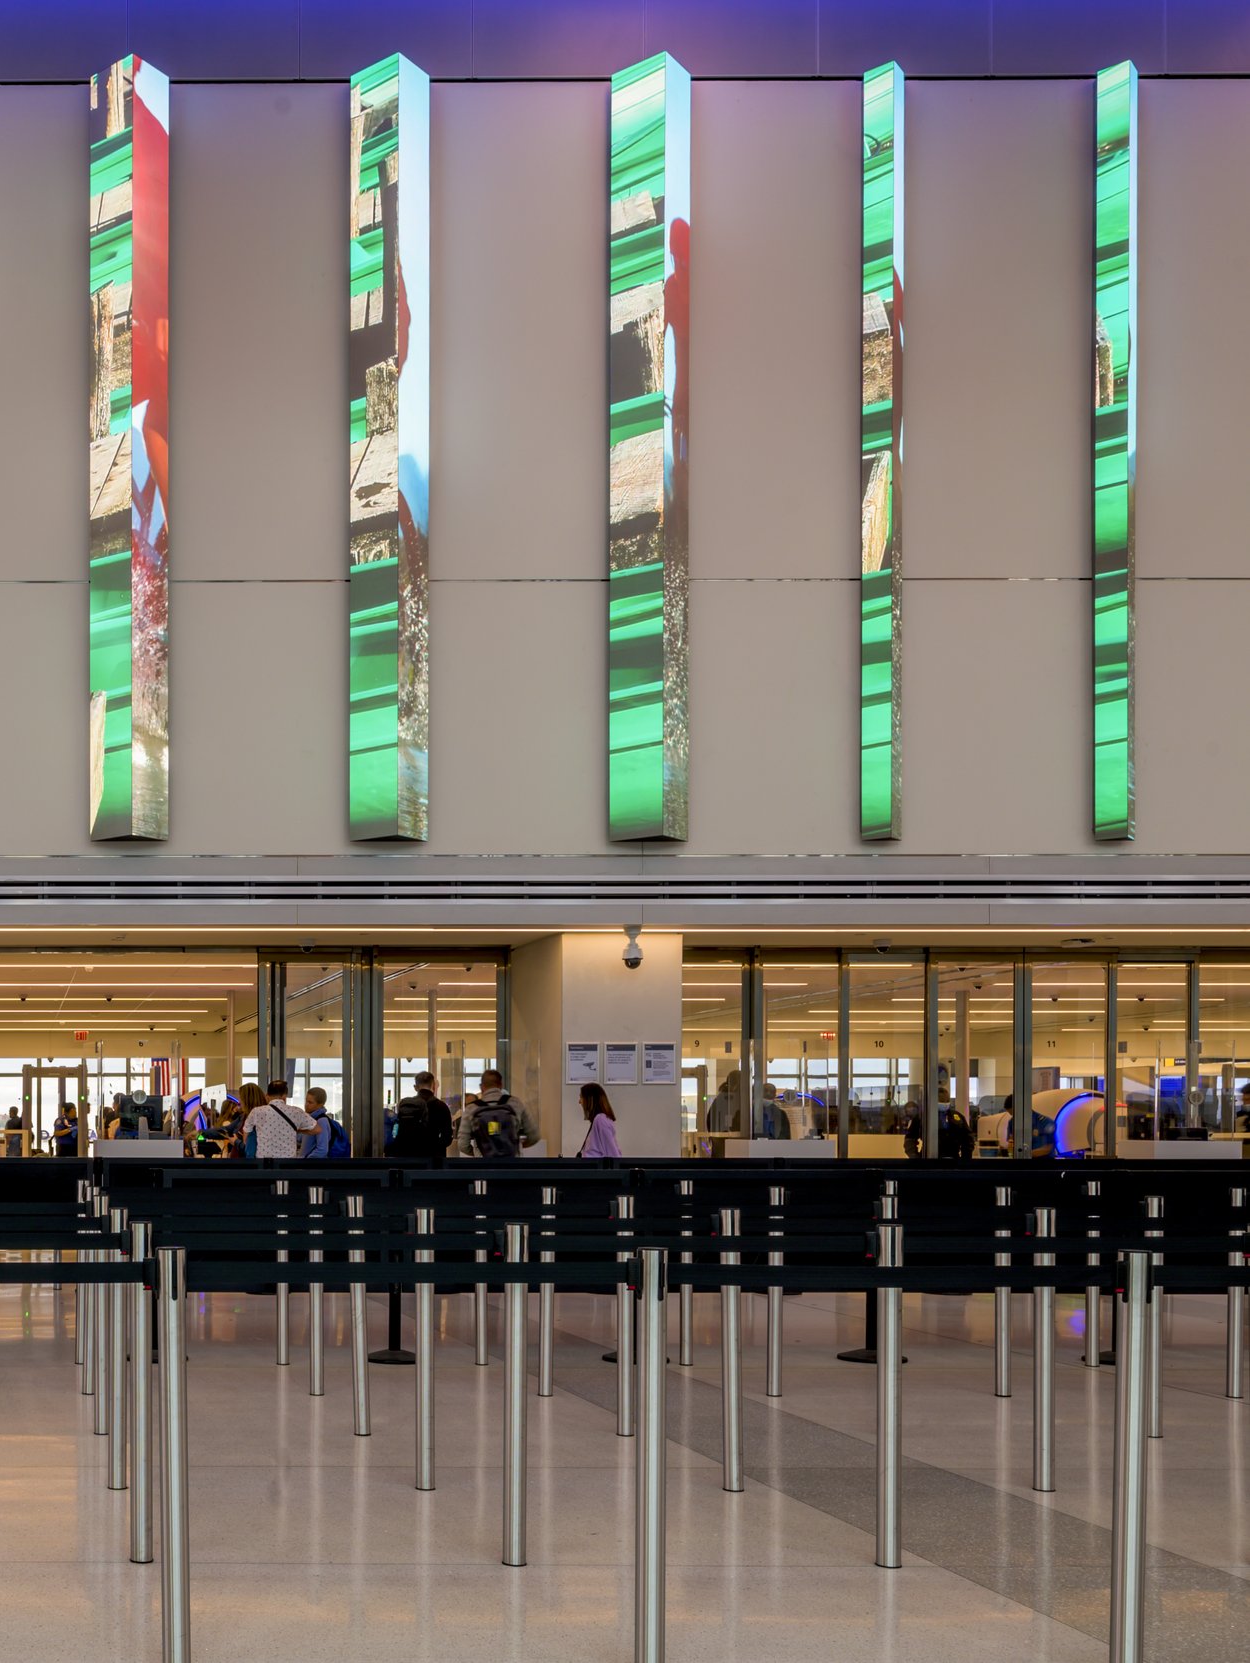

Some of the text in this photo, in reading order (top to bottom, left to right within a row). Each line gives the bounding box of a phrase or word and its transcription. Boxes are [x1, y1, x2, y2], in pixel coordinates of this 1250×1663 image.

[328, 1040, 334, 1048] 7
[694, 1040, 700, 1048] 9
[874, 1040, 884, 1048] 10
[1047, 1040, 1056, 1048] 11
